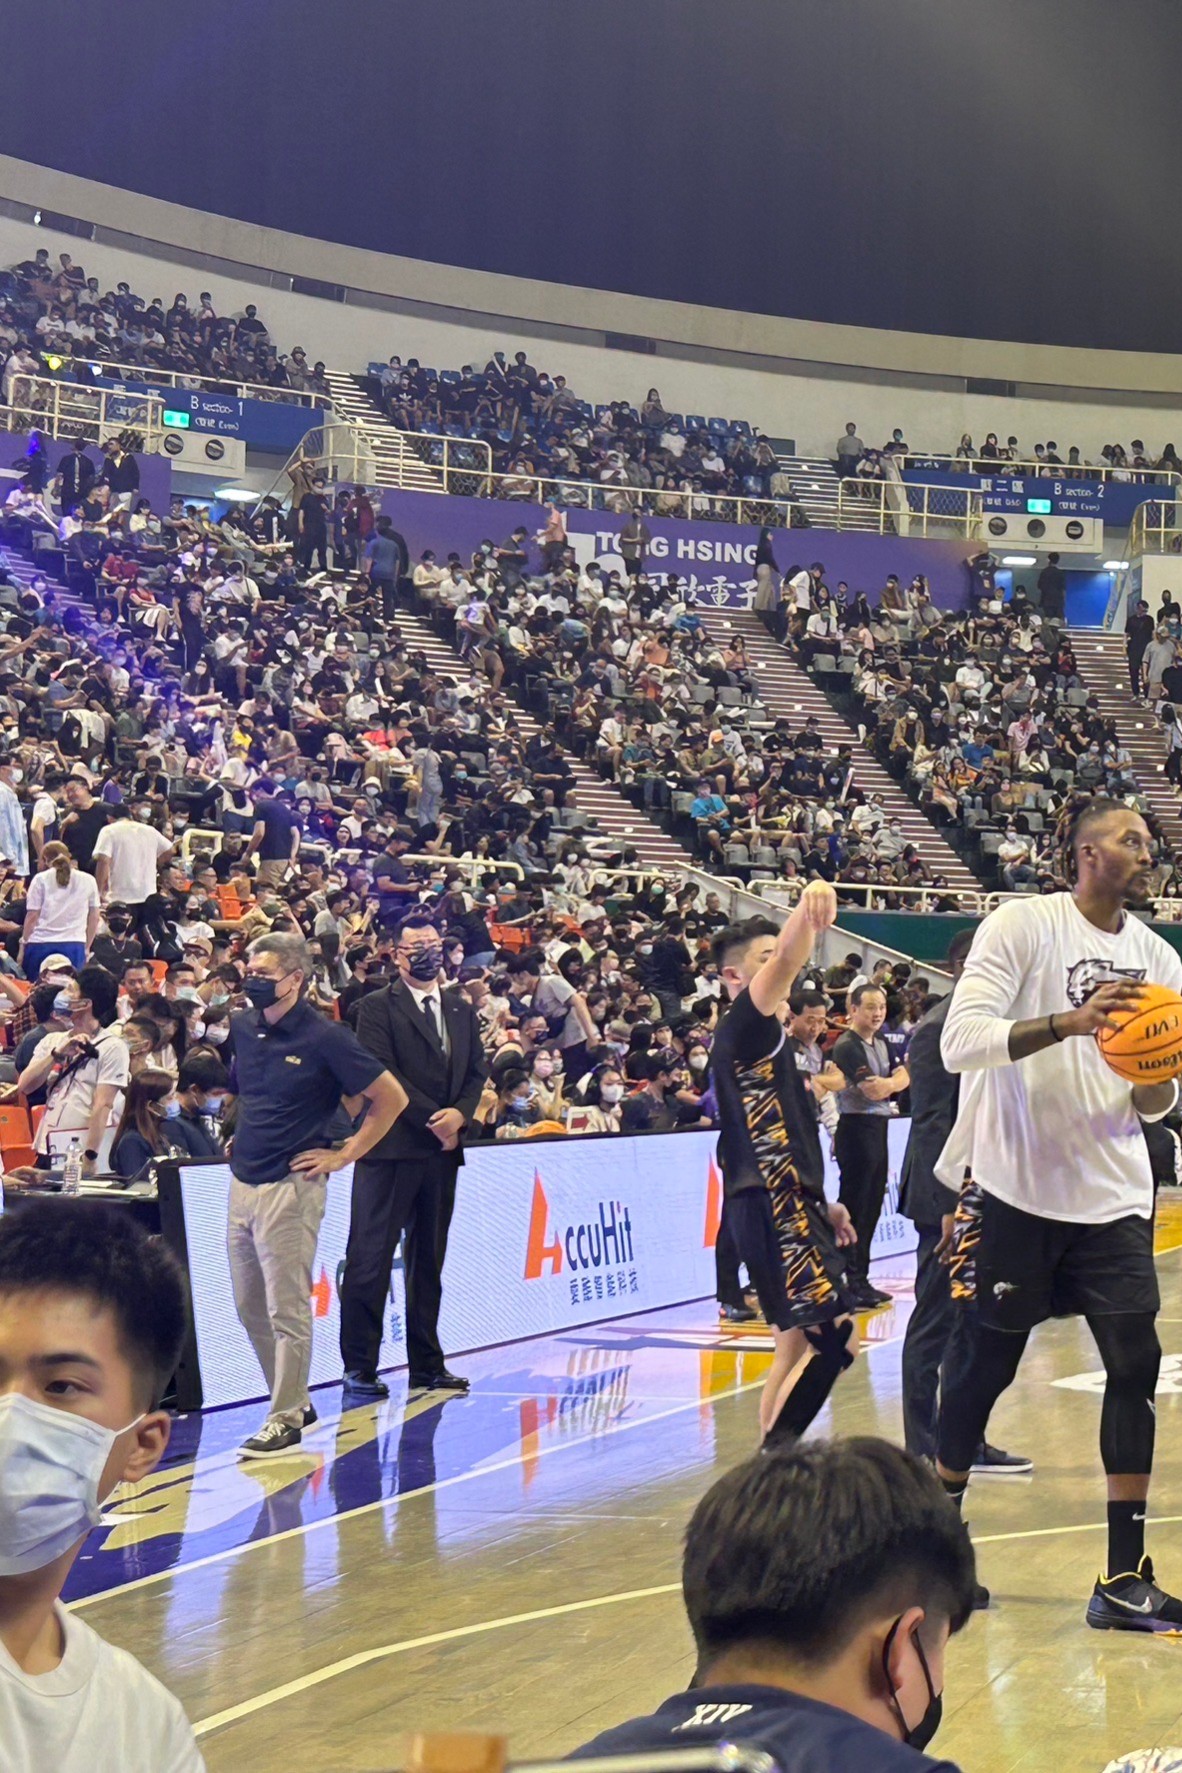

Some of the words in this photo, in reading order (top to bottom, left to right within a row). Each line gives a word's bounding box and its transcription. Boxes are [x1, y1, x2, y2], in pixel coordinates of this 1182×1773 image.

[190, 395, 199, 410] B
[1054, 482, 1062, 495] B
[1097, 484, 1105, 498] 2
[596, 531, 669, 557] TOG
[677, 538, 758, 565] HSING
[523, 1165, 635, 1280] AccuHit
